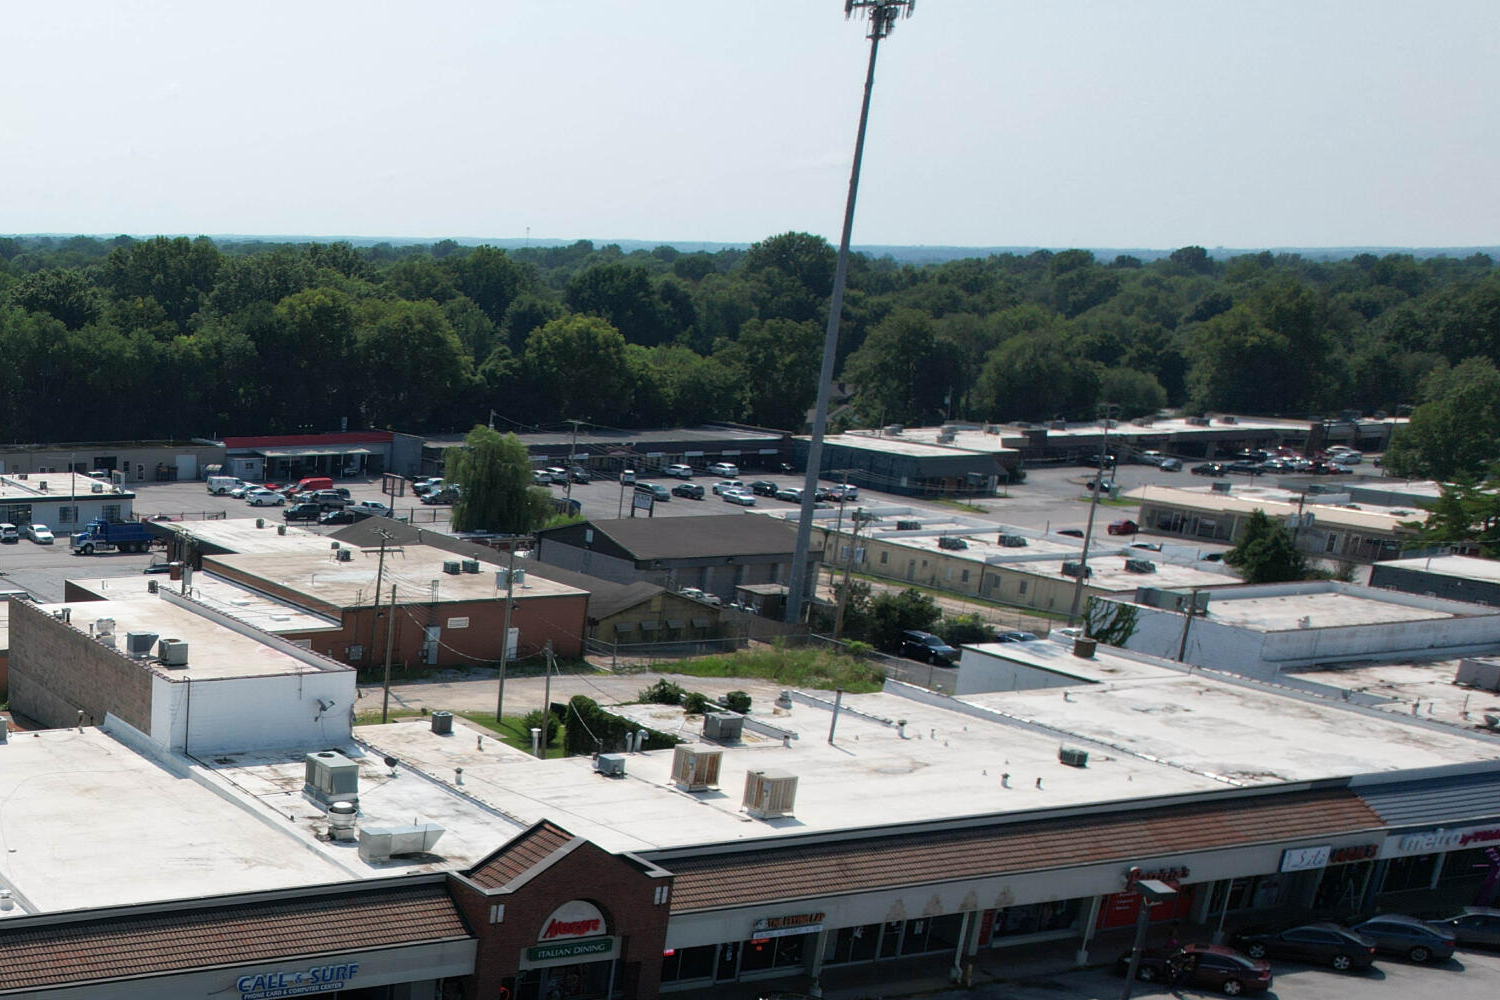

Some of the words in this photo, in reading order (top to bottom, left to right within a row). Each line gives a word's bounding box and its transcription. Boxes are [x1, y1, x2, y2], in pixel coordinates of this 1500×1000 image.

[538, 947, 571, 960] ITALIAN
[573, 943, 605, 954] DINING
[237, 972, 288, 993] CALL
[293, 973, 303, 984] &
[310, 963, 359, 984] SURF
[244, 992, 265, 1000] PHONE
[266, 990, 282, 998] CARD
[289, 985, 320, 995] COMPUTER
[320, 982, 342, 991] CENTER
